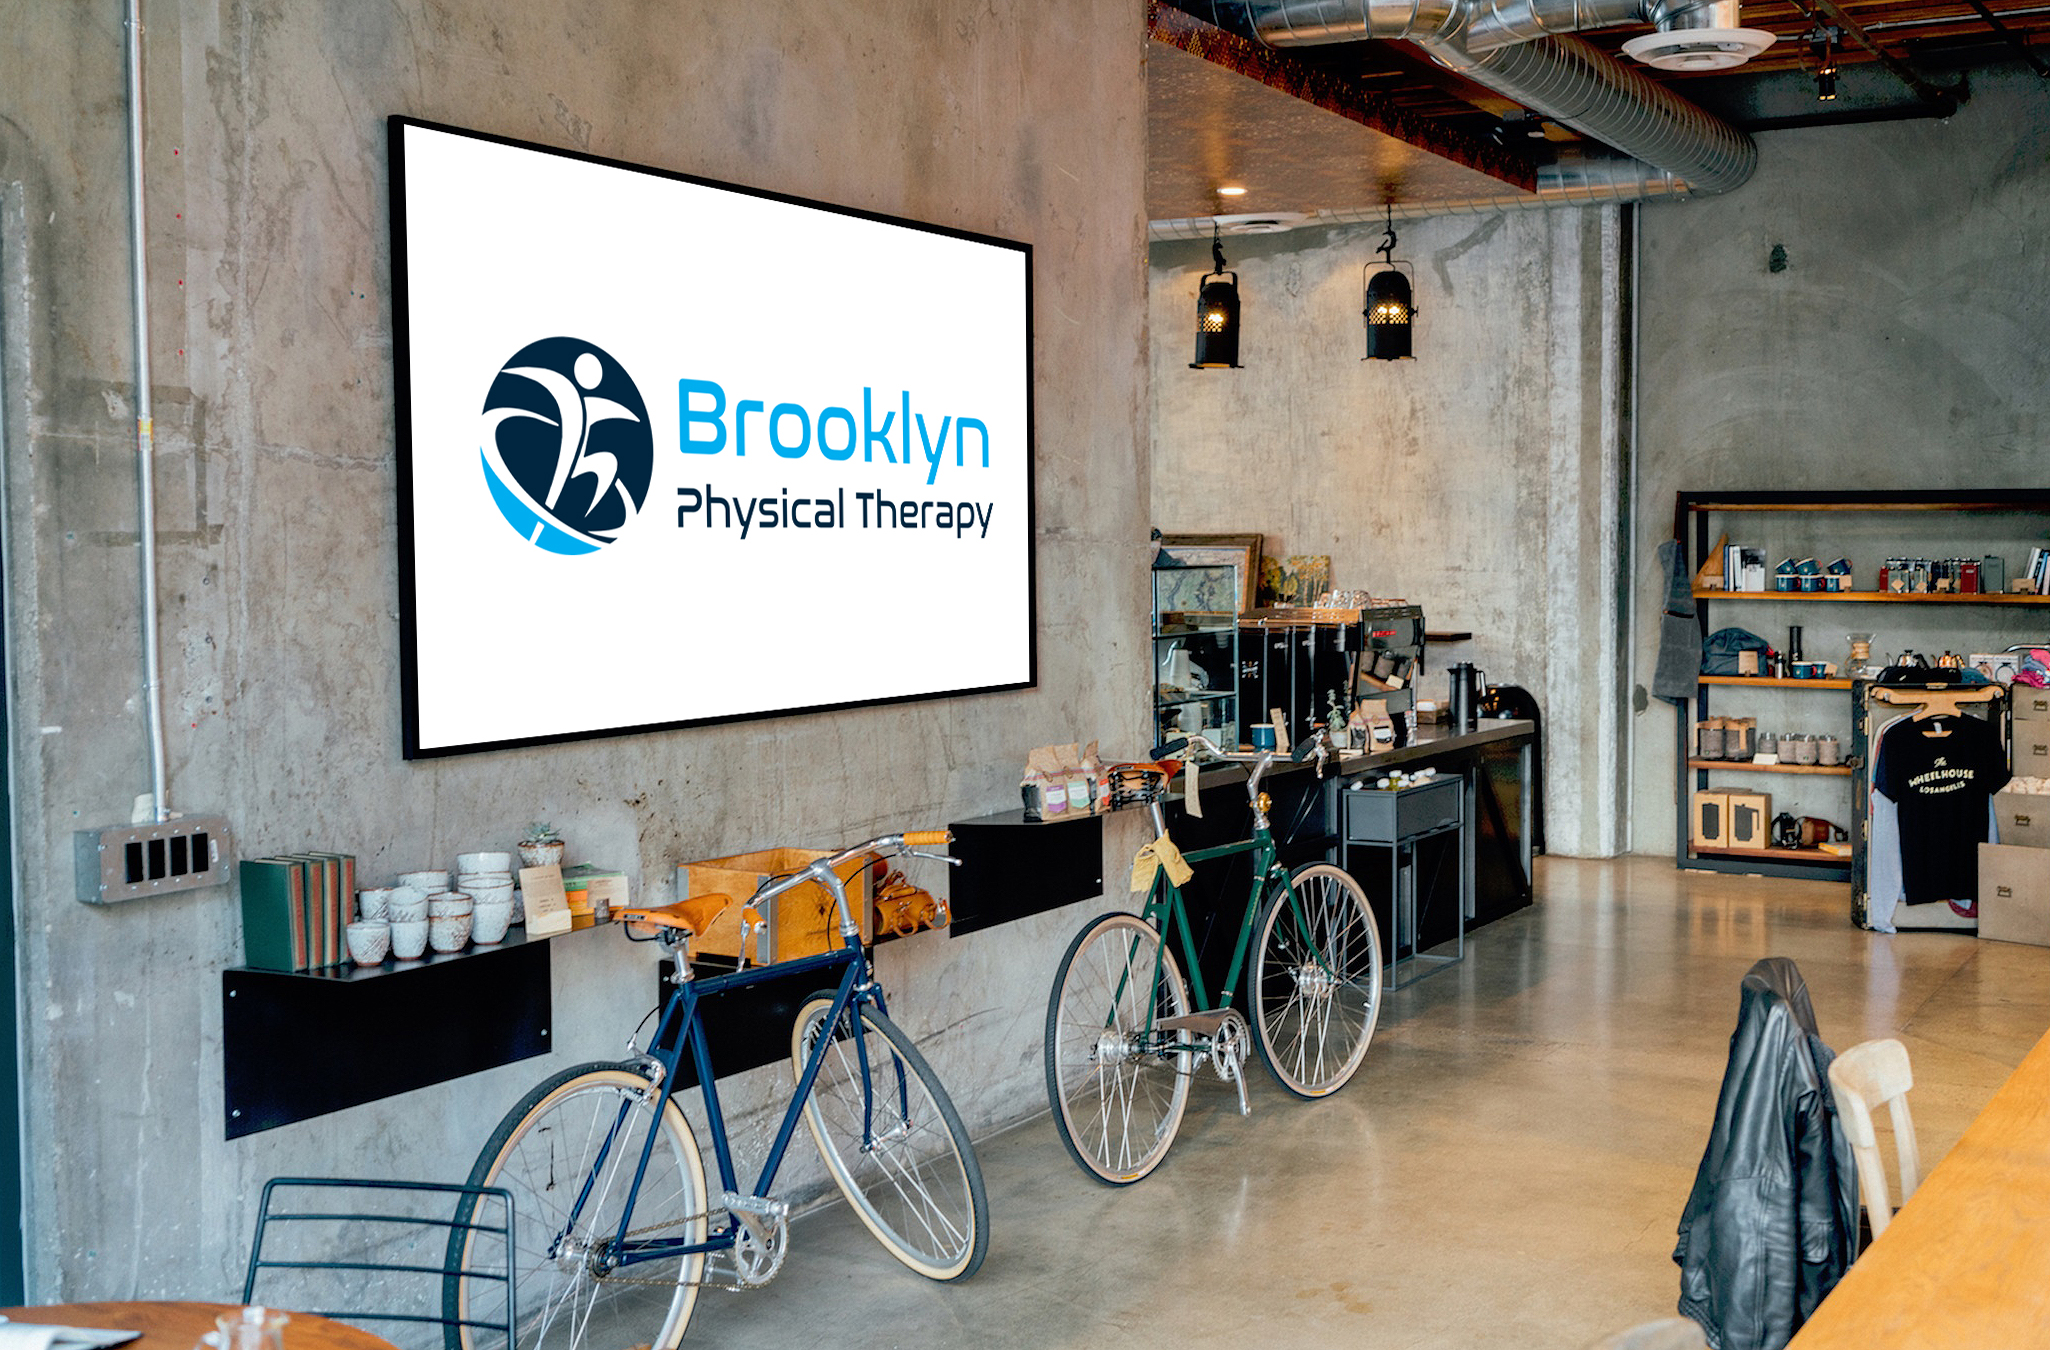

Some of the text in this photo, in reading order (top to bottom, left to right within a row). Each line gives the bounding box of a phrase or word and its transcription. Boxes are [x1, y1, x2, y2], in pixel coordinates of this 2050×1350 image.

[679, 378, 989, 485] Brooklyn
[677, 484, 993, 540] Physical Therapy
[1908, 769, 1974, 788] WHEELHOUSE
